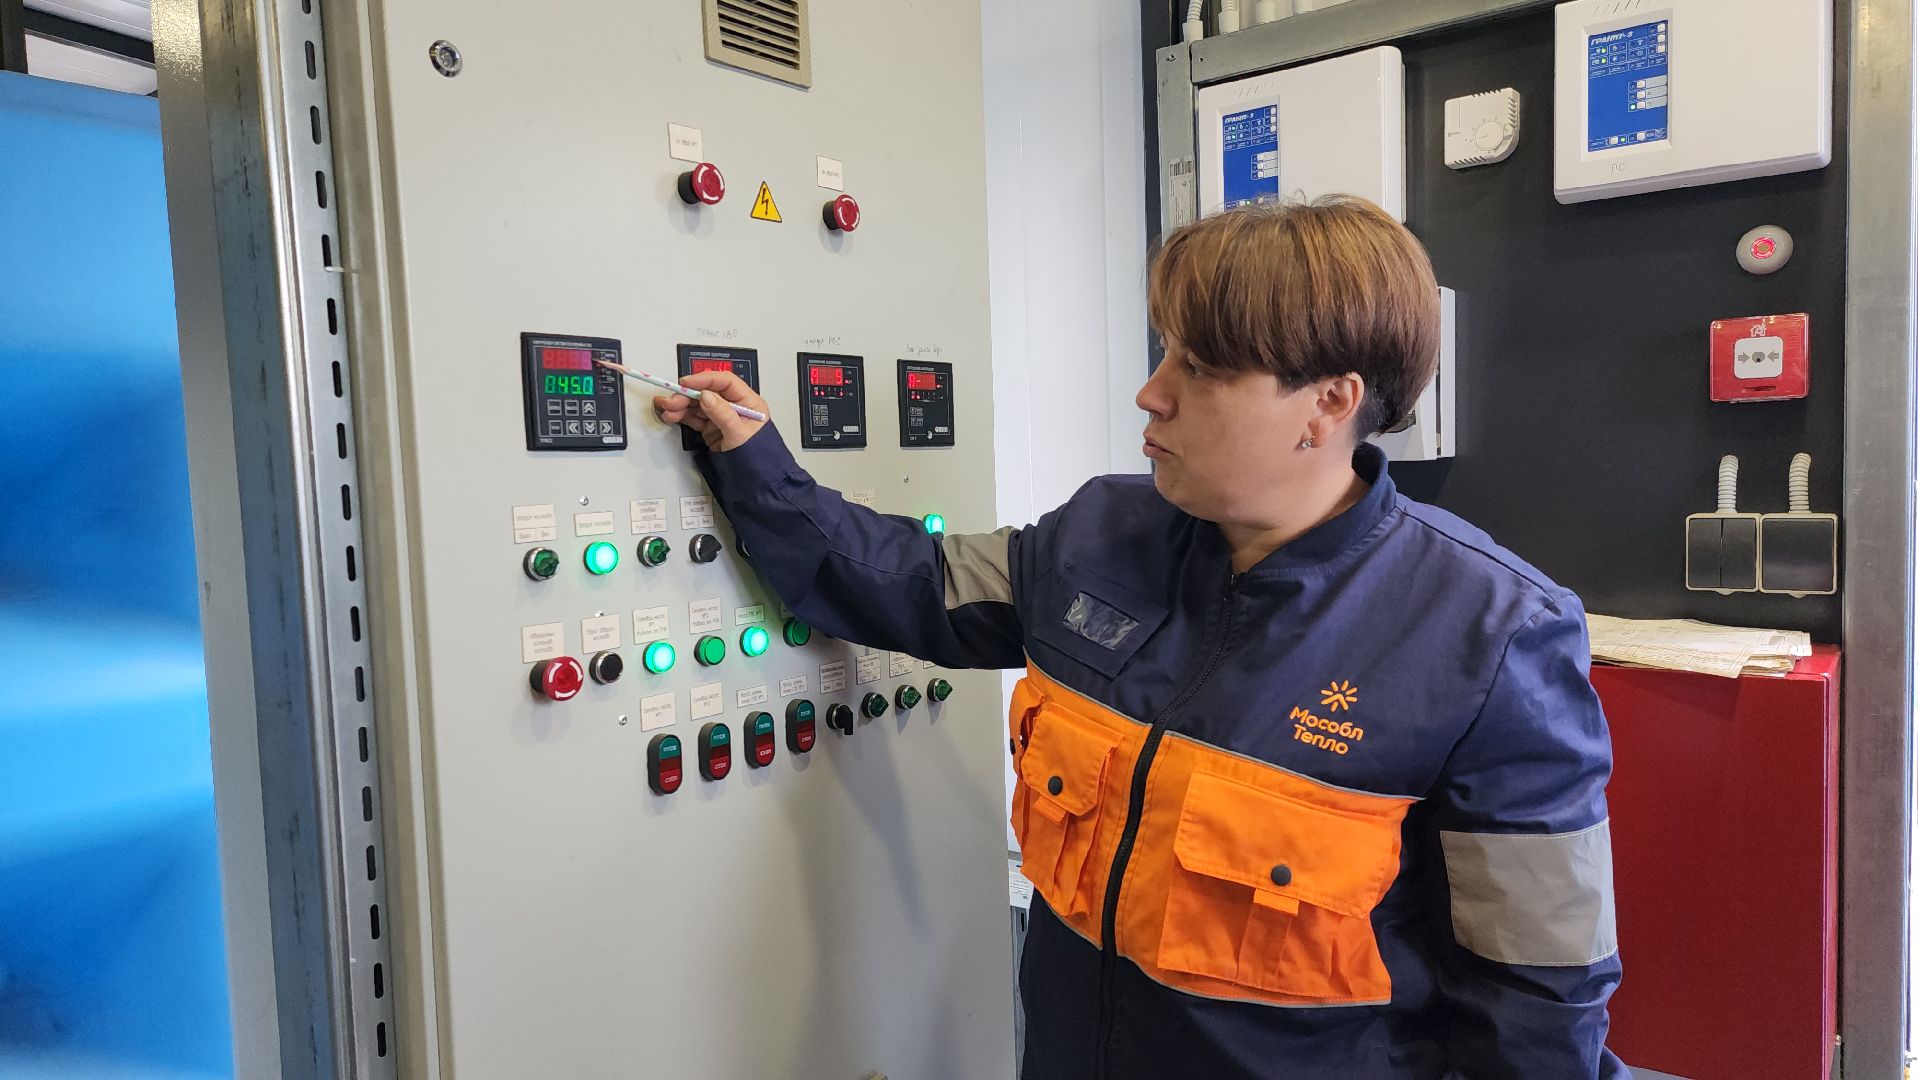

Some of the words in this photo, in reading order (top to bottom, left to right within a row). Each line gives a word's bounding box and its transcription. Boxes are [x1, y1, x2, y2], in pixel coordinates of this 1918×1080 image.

[1590, 31, 1634, 46] ГРАНИТ-3
[1289, 706, 1364, 741] Мособл
[1294, 723, 1349, 755] Тепло
